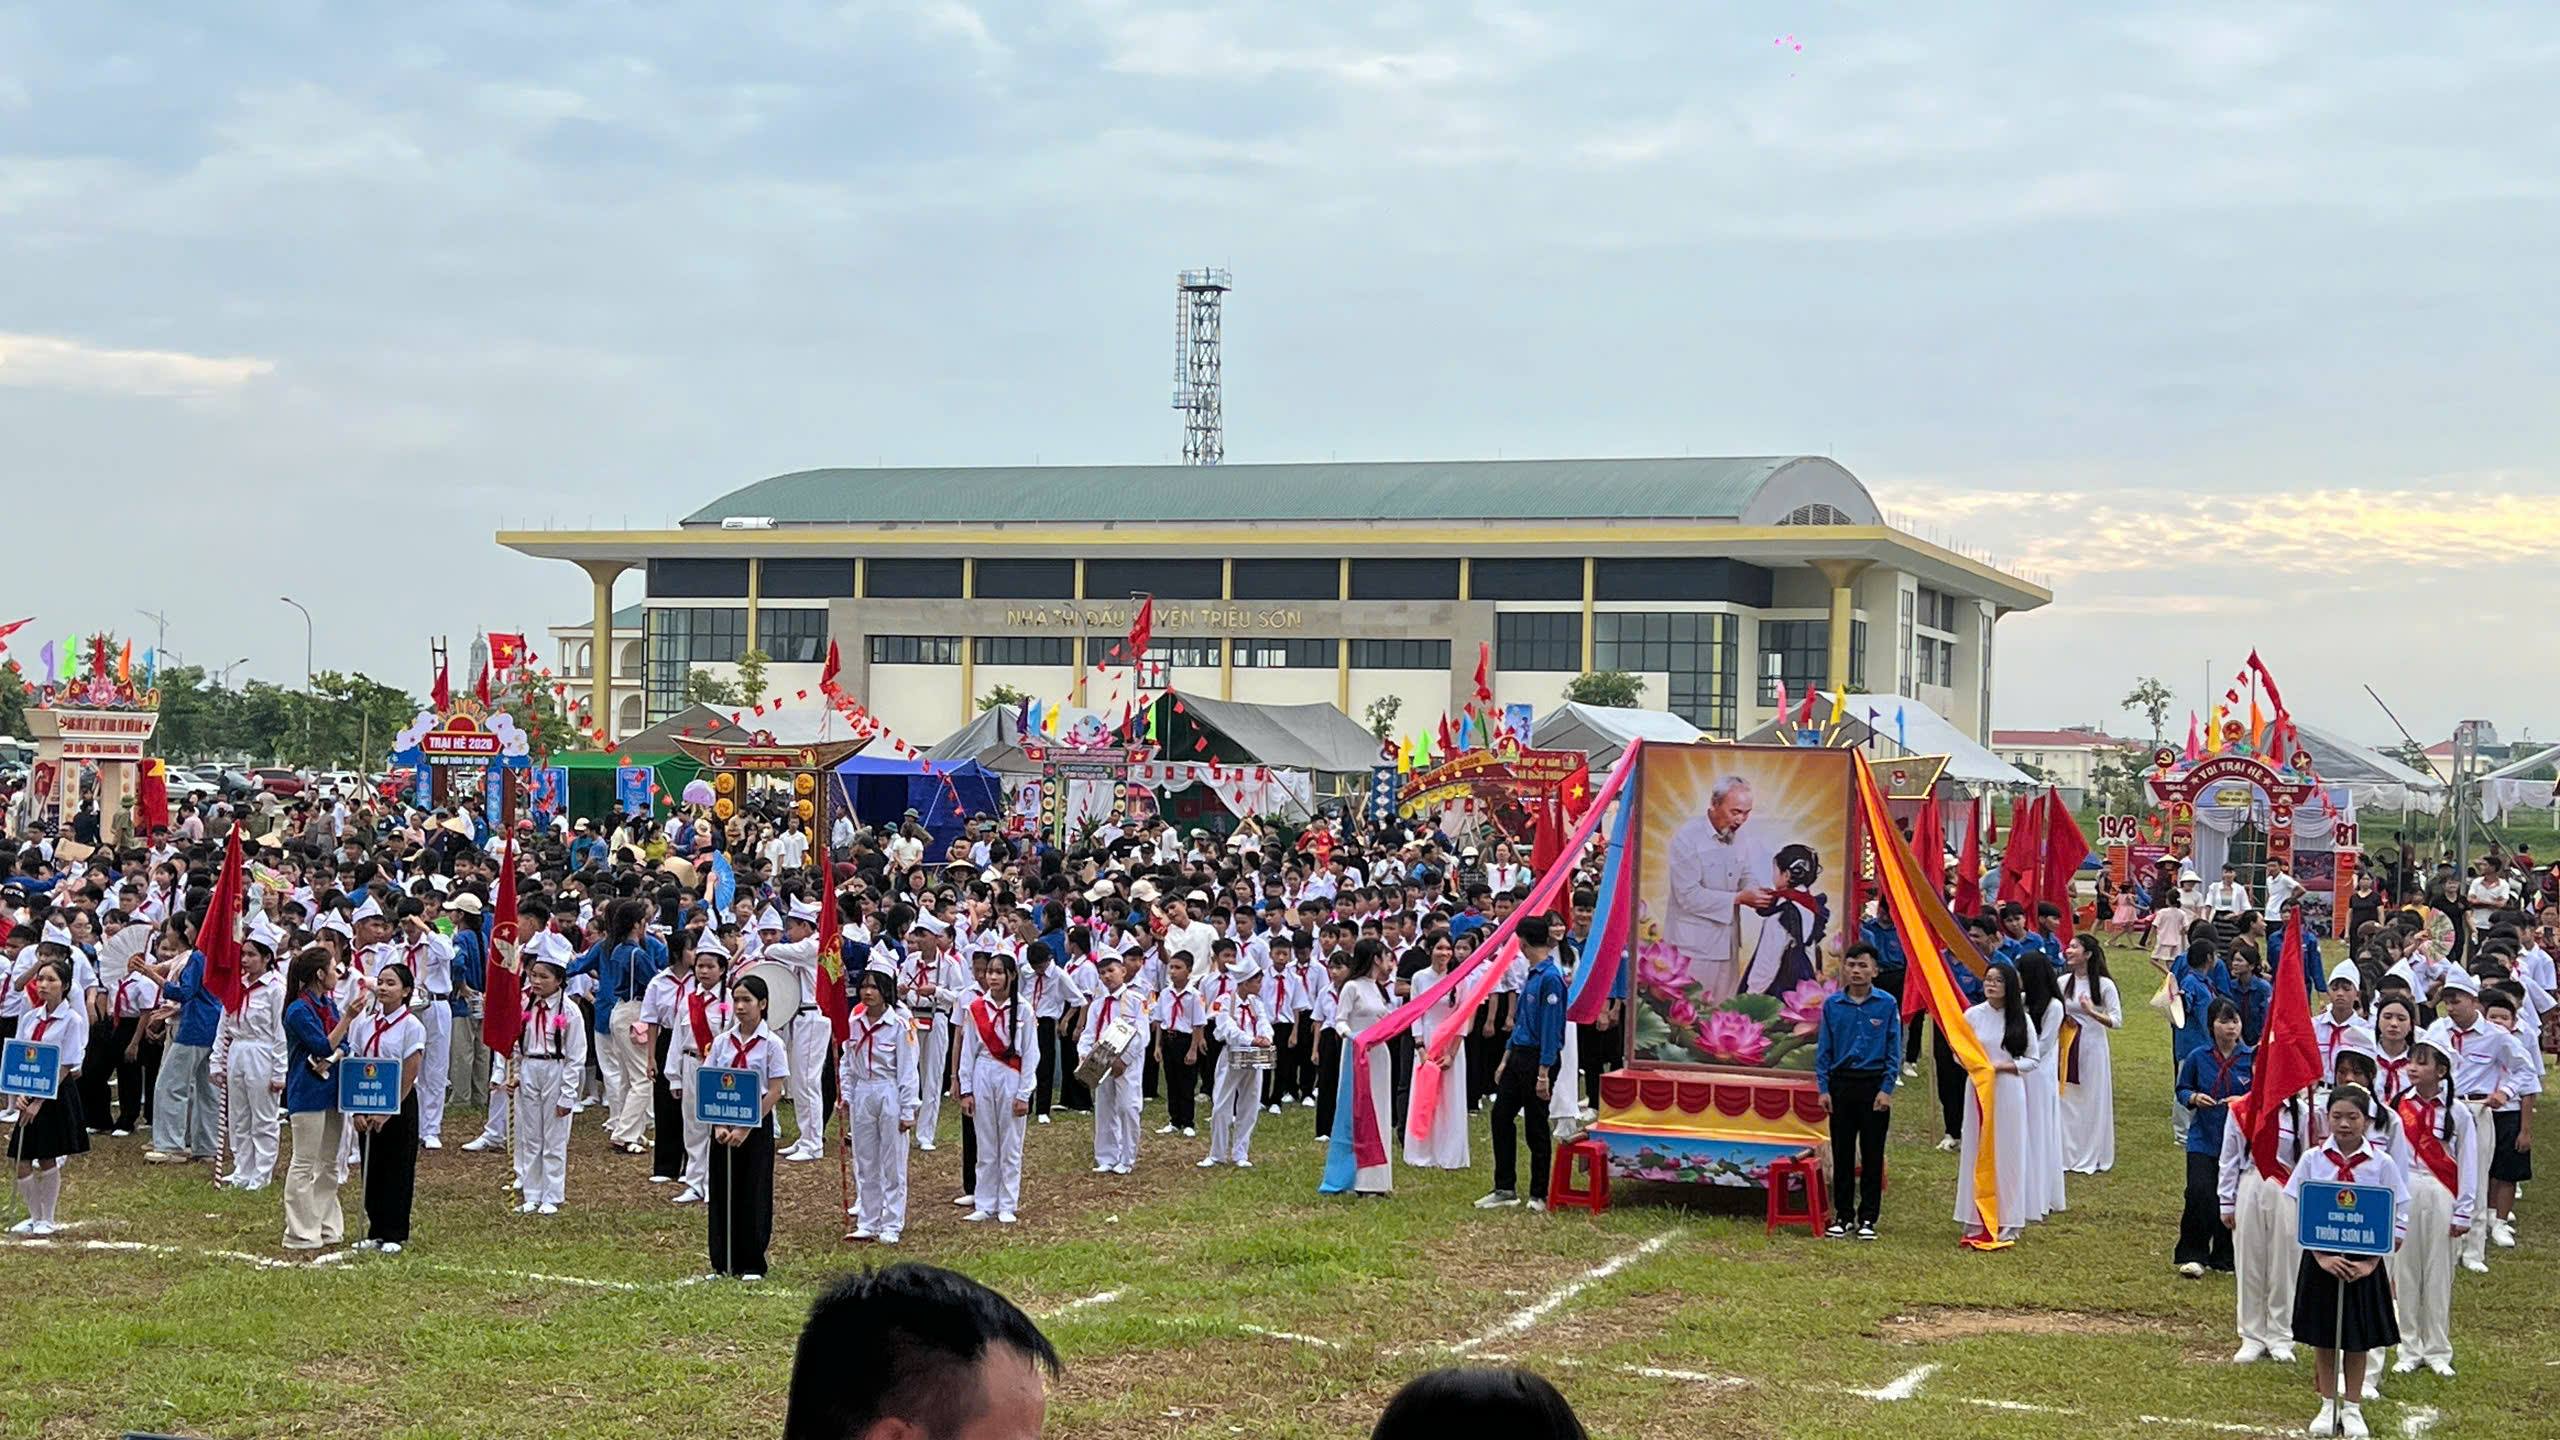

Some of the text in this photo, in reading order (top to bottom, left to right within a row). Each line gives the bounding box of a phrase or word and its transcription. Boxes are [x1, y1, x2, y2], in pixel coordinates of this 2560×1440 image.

[1007, 604, 1048, 626] NHÀ
[1201, 606, 1251, 632] TRIỆU
[1258, 607, 1302, 628] SƠN
[429, 736, 452, 751] TRẠI
[453, 735, 467, 749] HÈ
[2219, 761, 2246, 774] TRẠI
[2098, 815, 2137, 839] 19/8
[2336, 822, 2358, 847] 81
[2327, 1211, 2364, 1225] CHI ĐỘI
[2315, 1224, 2376, 1245] THÔN SƠN HÀ
